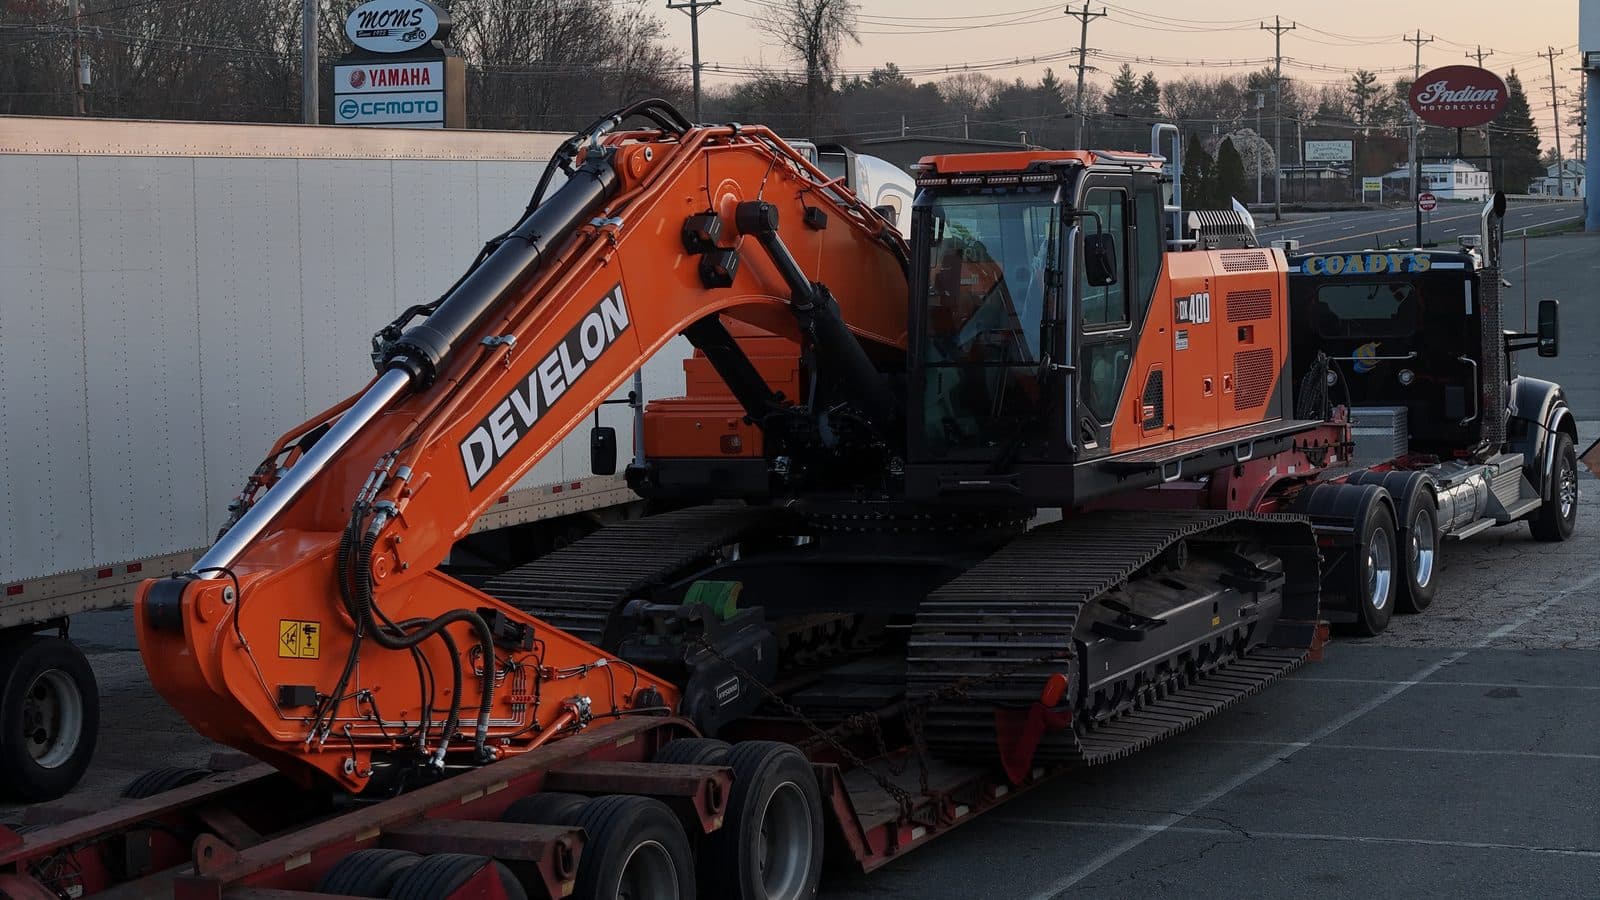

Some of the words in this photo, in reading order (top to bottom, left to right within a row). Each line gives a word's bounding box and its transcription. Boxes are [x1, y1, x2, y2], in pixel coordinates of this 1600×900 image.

[358, 8, 423, 28] MOMS
[369, 67, 430, 87] YAMAHA
[1417, 80, 1498, 104] Indian
[361, 101, 438, 114] CFMOTO
[460, 285, 629, 487] DEVELON
